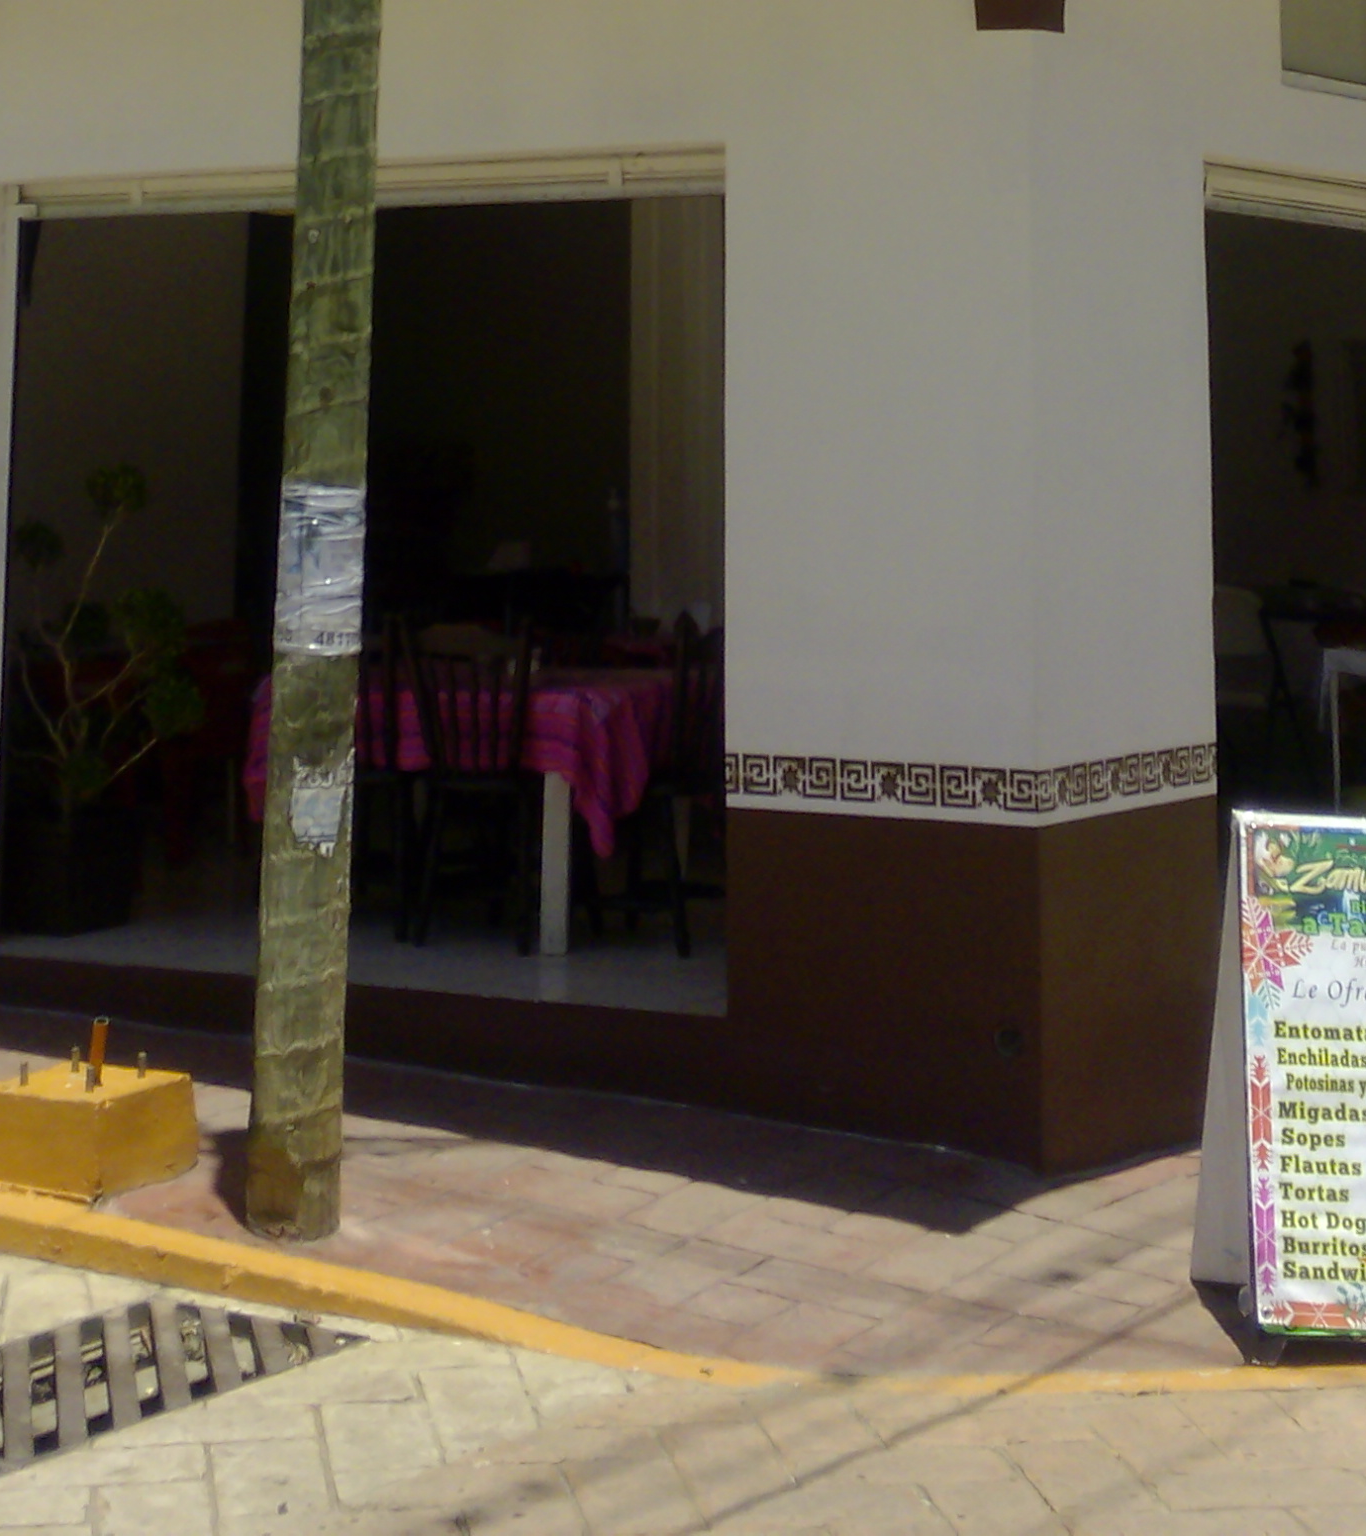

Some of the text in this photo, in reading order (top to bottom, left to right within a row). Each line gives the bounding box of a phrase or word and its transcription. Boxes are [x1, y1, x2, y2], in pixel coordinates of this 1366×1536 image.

[1302, 915, 1320, 936] a
[1330, 939, 1347, 951] La
[1291, 978, 1318, 1000] Le
[1286, 1072, 1355, 1094] Potosinas
[1281, 1127, 1346, 1151] Sopes
[1280, 1155, 1363, 1176] Flautas
[1279, 1182, 1350, 1202] Tortas
[1280, 1210, 1366, 1234] Hot Dog
